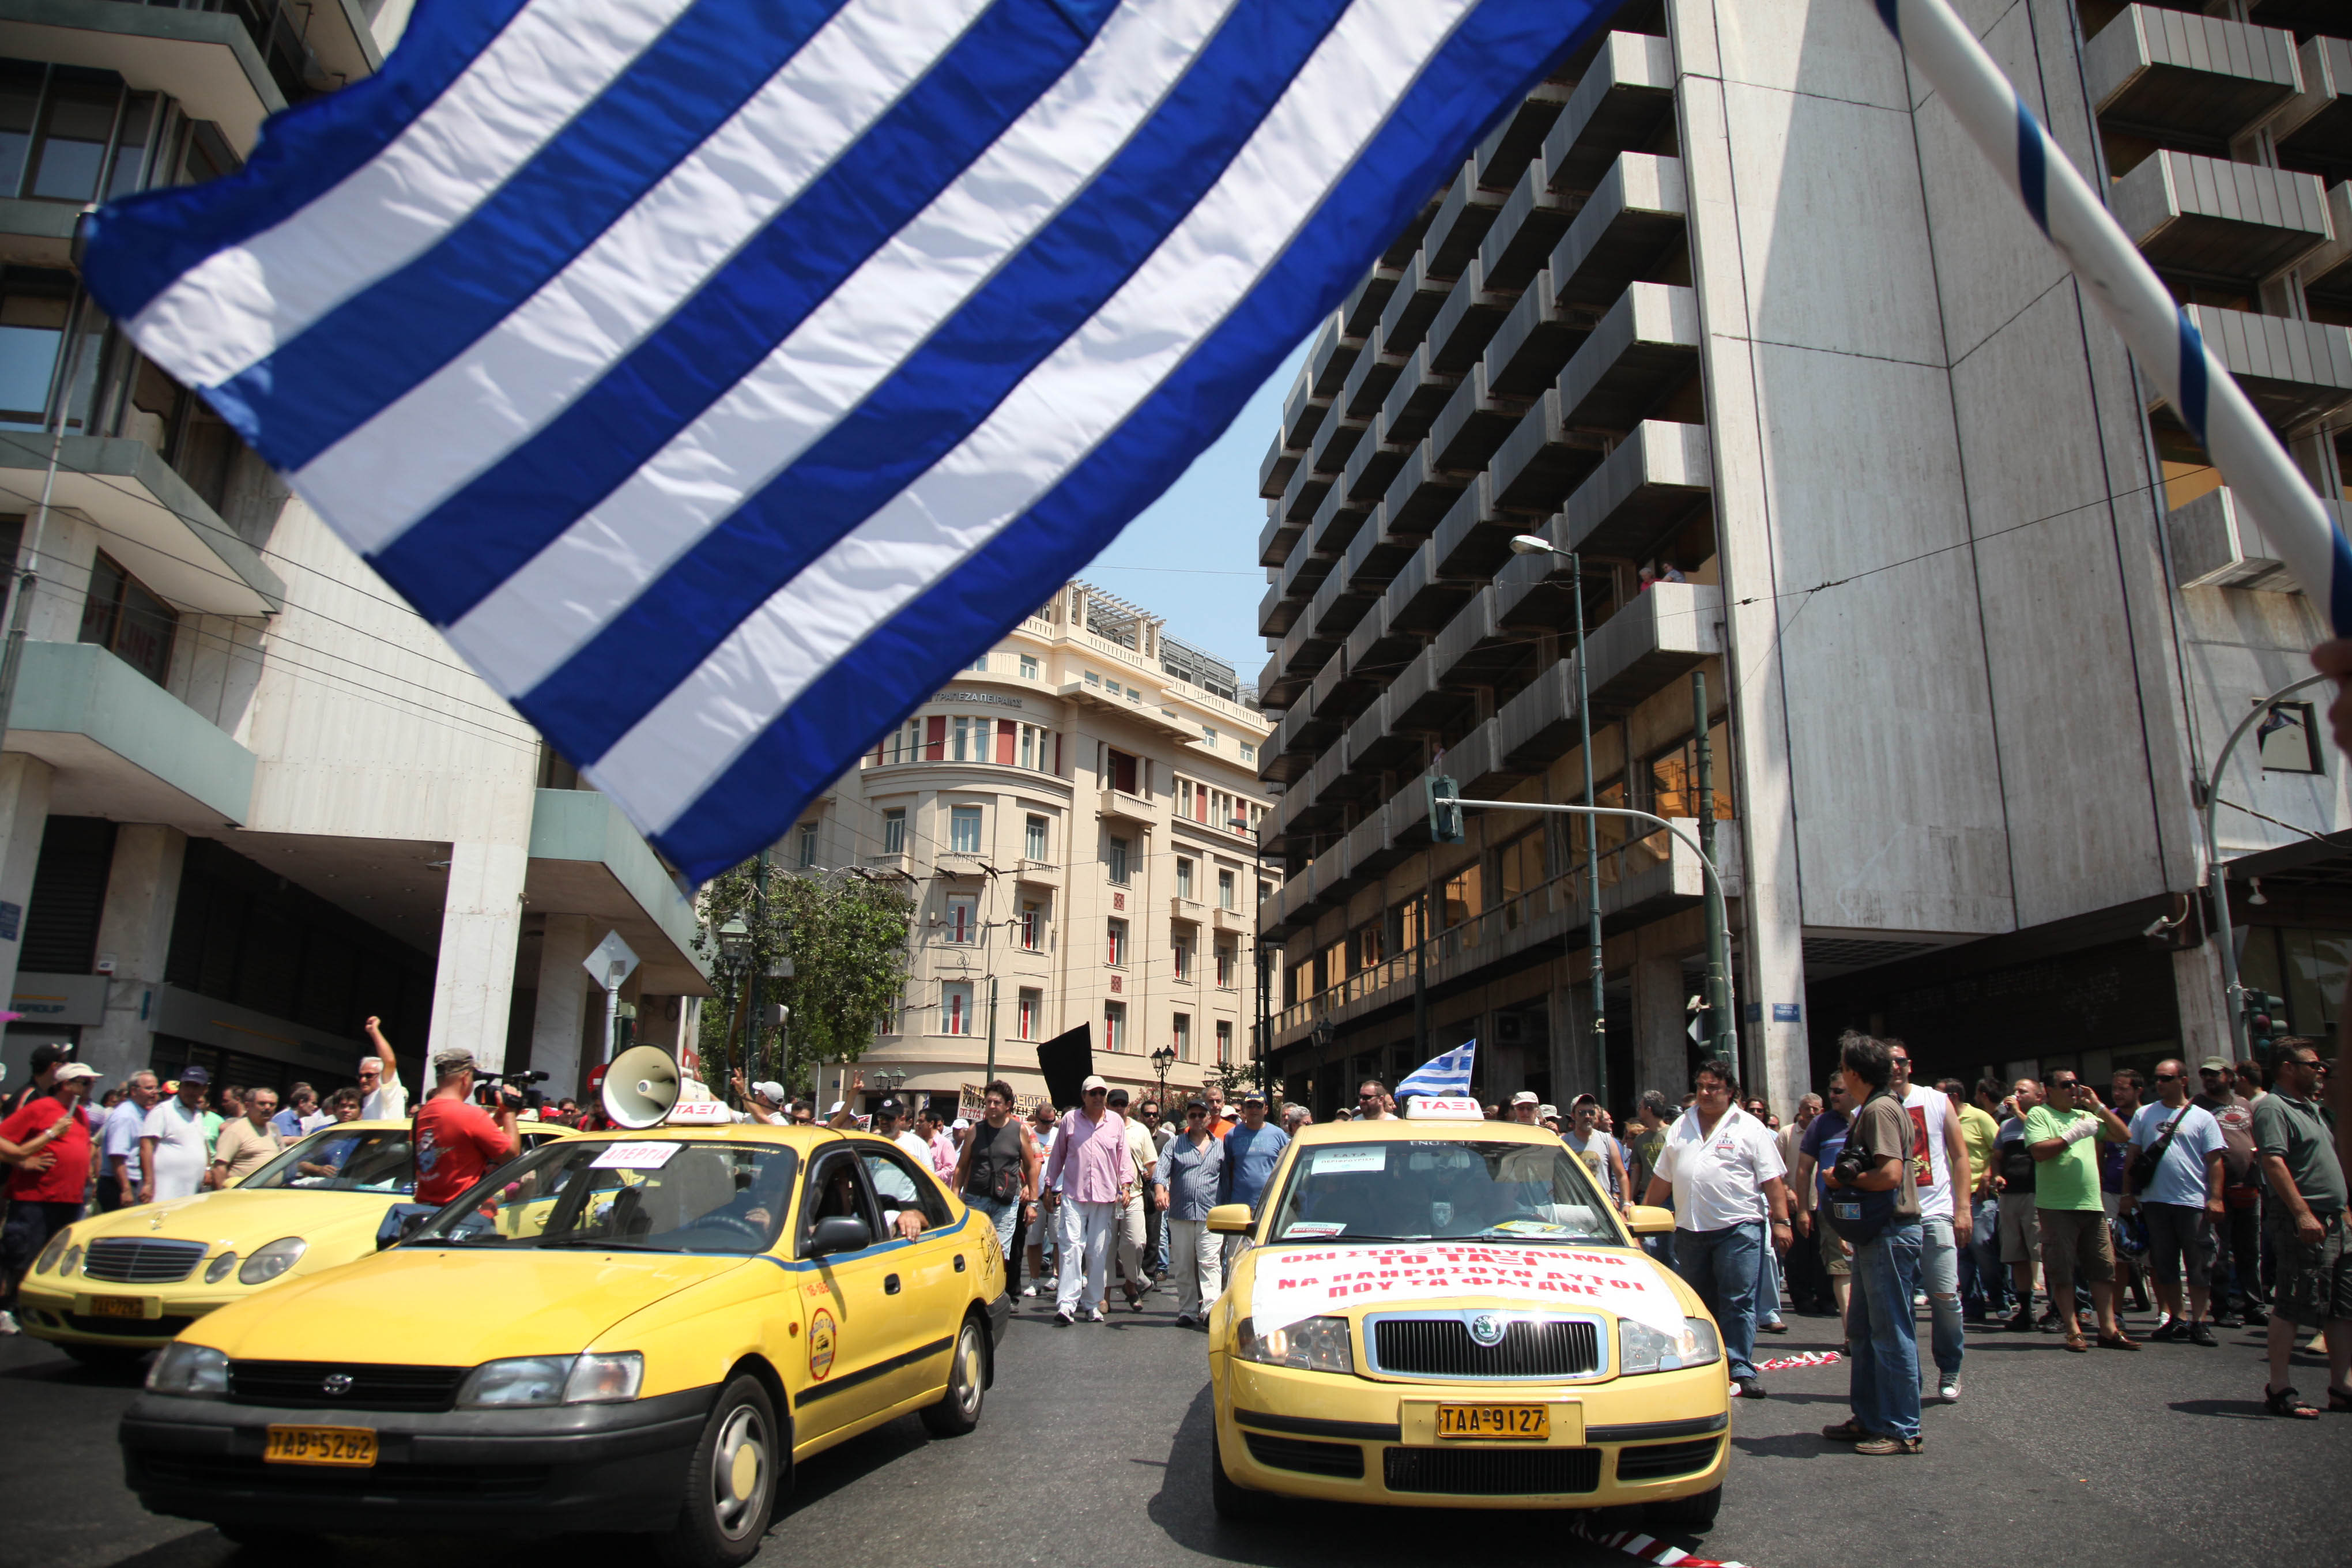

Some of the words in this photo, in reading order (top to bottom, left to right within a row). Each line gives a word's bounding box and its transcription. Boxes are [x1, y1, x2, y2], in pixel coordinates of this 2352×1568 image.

[935, 692, 978, 702] ΤΡΑΠΕΖΑ
[980, 693, 1022, 707] ΠΕΙΡΑΙΩΣ
[962, 1095, 975, 1107] ΚΑΙ
[1418, 1102, 1475, 1110] ΤΑΞΙ
[675, 1105, 718, 1114] ΤΑΞΙ
[602, 1148, 672, 1160] ΑΠΕΡΓΙΑ
[1281, 1252, 1336, 1263] ΟΧΙ
[1345, 1249, 1405, 1257] ΣΤΟ
[1415, 1246, 1628, 1265] ΞΕΠΟΥΛΗΜΑ
[1372, 1255, 1428, 1265] ΤΟ
[1439, 1254, 1538, 1266] ΤΑΞΙ
[1278, 1277, 1319, 1290] ΝΑ
[1333, 1267, 1533, 1282] ΠΛΗΡΩΣΟΥΝ
[1547, 1272, 1645, 1291] ΑΥΤΟΙ
[1329, 1281, 1394, 1298] ΠΟΥ
[1407, 1278, 1450, 1287] ΤΑ
